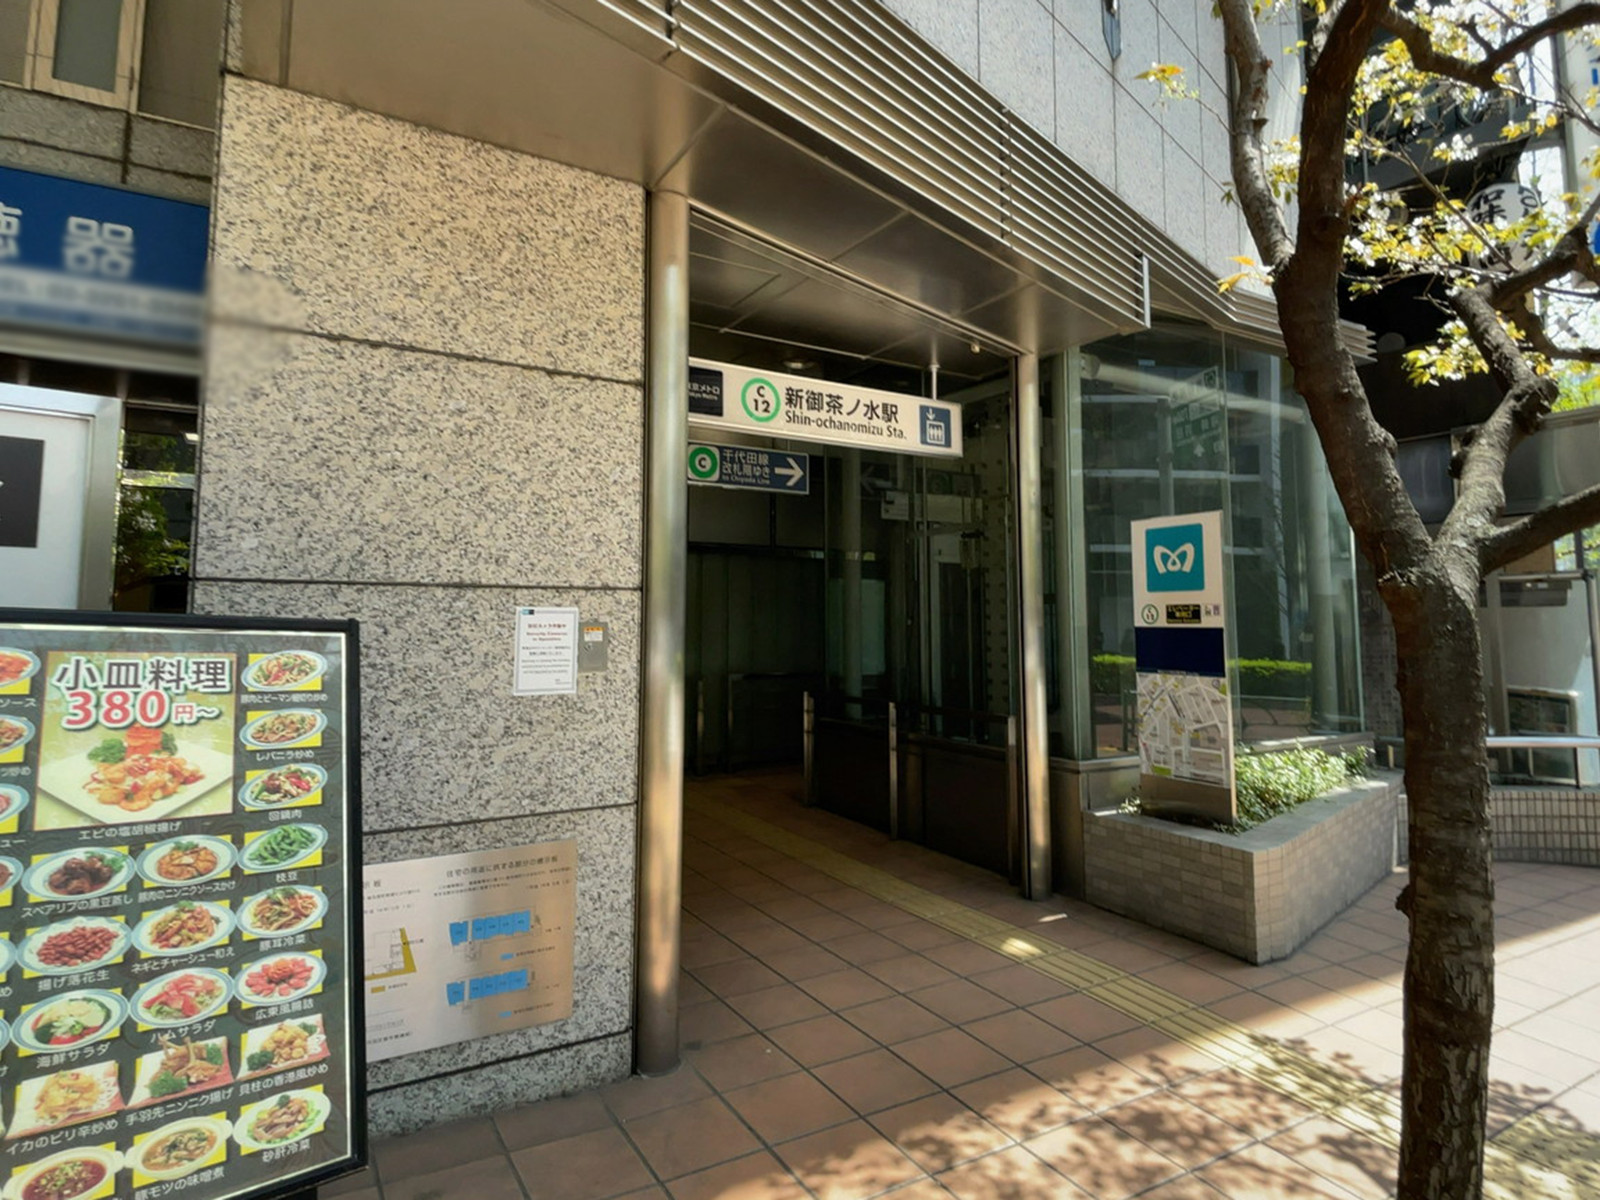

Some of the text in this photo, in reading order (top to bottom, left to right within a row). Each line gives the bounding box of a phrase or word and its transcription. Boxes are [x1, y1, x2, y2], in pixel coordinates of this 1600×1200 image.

[756, 385, 766, 398] C
[753, 399, 770, 413] 12
[785, 386, 899, 425] 新御茶ノ水駅
[785, 411, 907, 440] Shin-ochanomizu Sta.
[698, 457, 707, 469] C
[54, 657, 230, 692] 小皿料理
[276, 871, 298, 883] 枝豆
[36, 1041, 111, 1068] 海鮮サラダ
[6, 1118, 118, 1155] イカのピリ辛炒め
